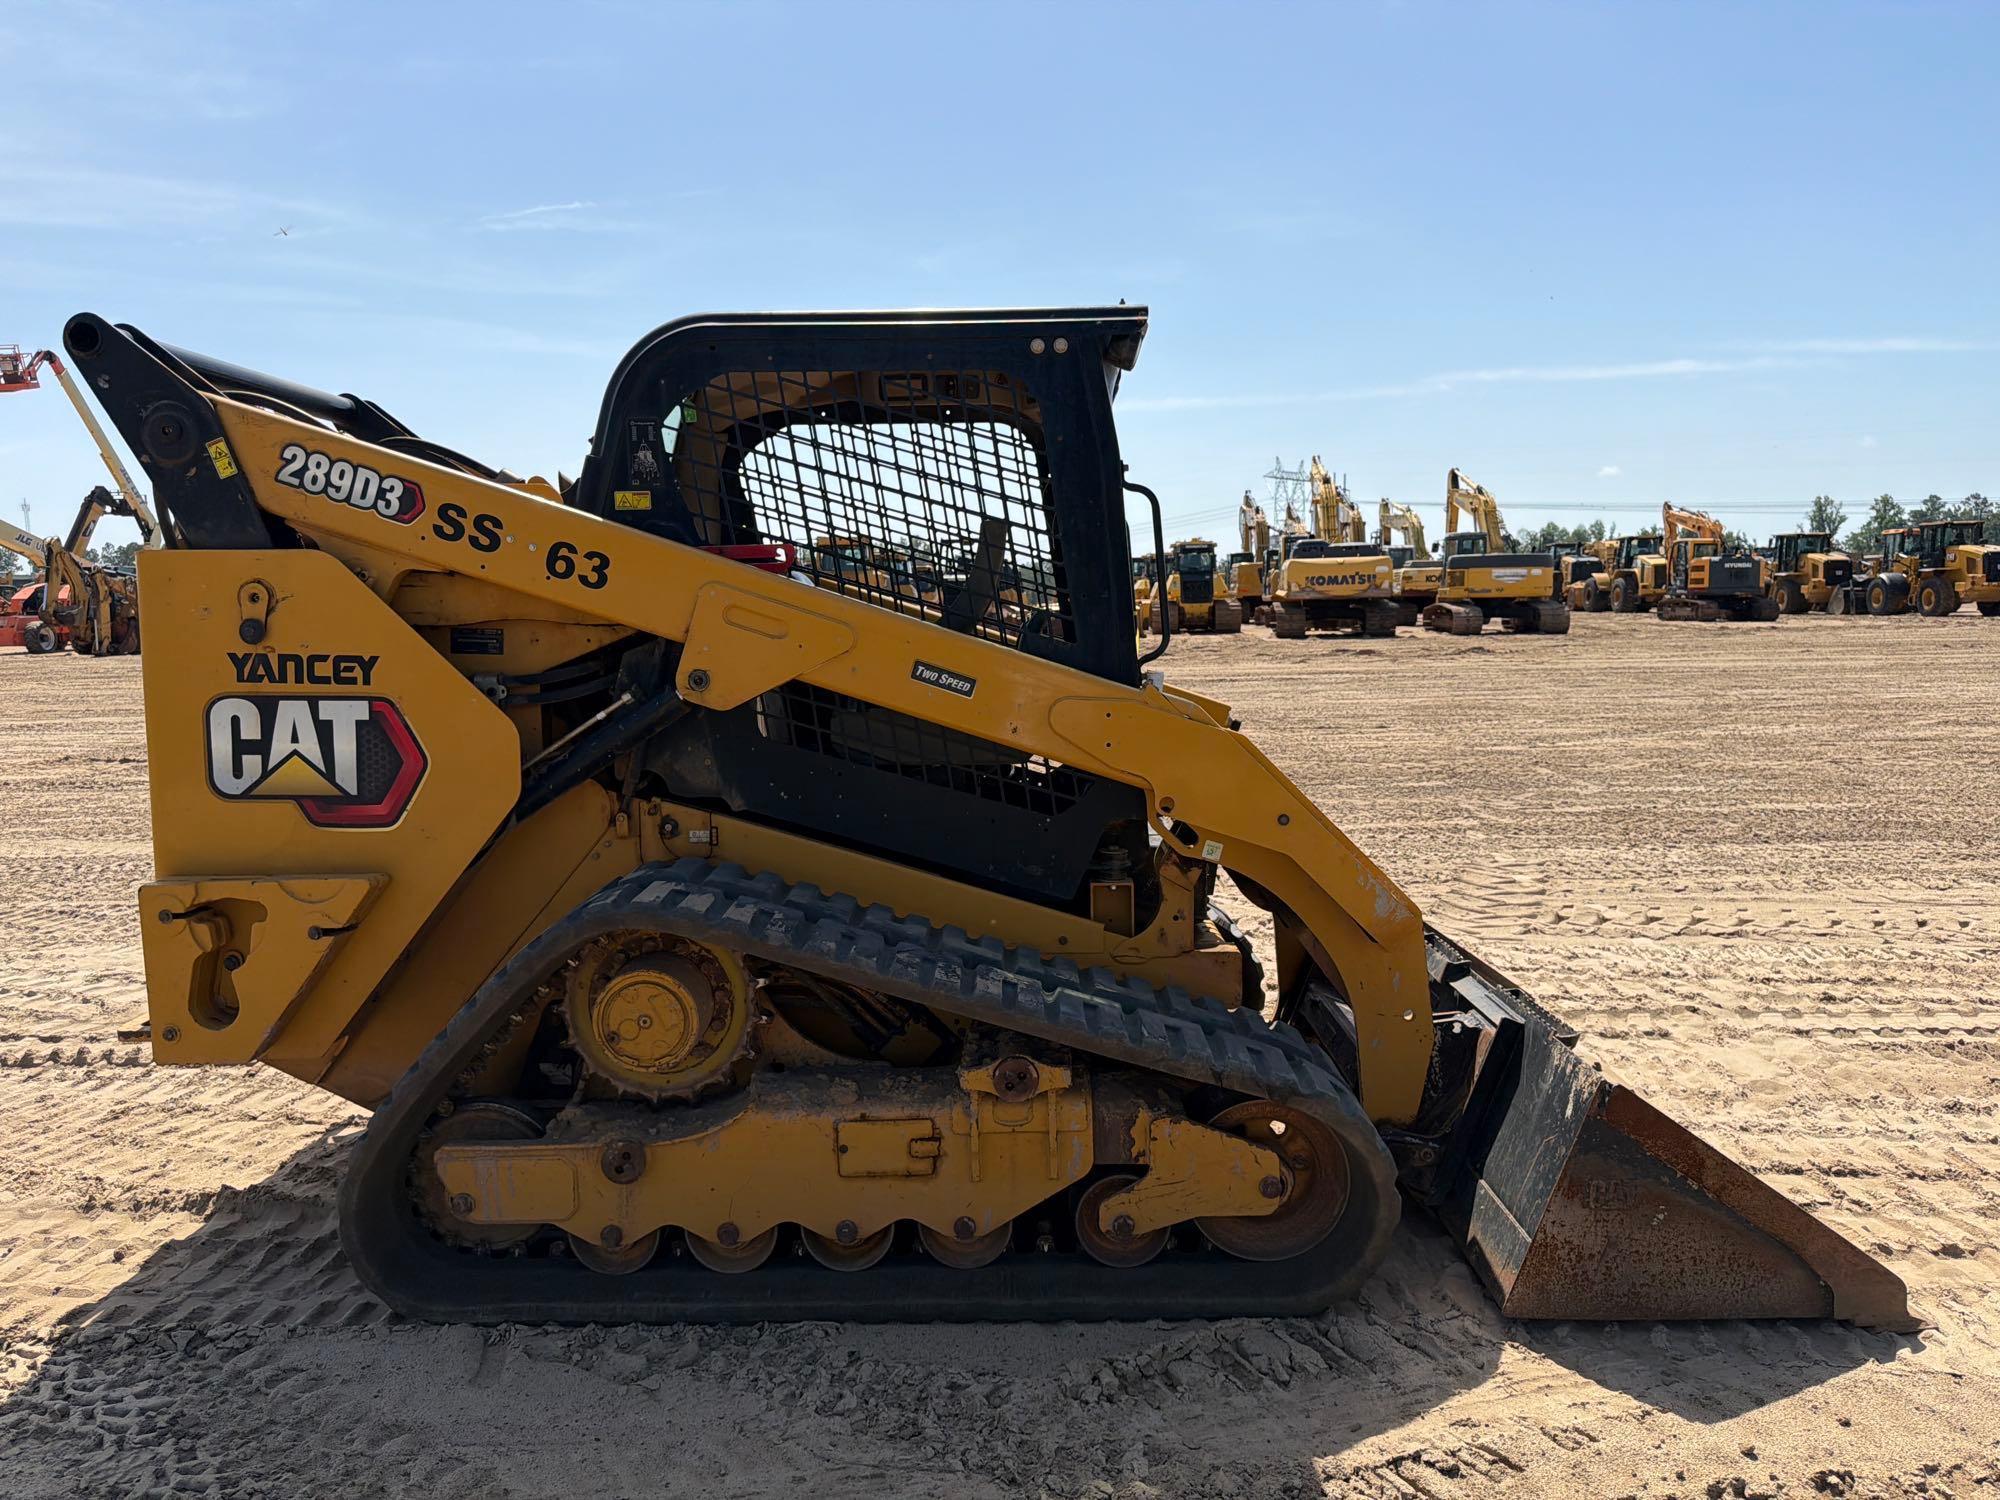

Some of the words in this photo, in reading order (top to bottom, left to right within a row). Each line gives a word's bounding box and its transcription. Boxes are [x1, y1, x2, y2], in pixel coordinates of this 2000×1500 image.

[278, 445, 404, 516] 289D3
[15, 534, 32, 546] JLG
[432, 502, 504, 553] SS
[545, 541, 611, 590] 63
[1305, 573, 1377, 586] KOMATSU
[226, 652, 380, 686] YANCEY
[209, 698, 370, 796] CAT
